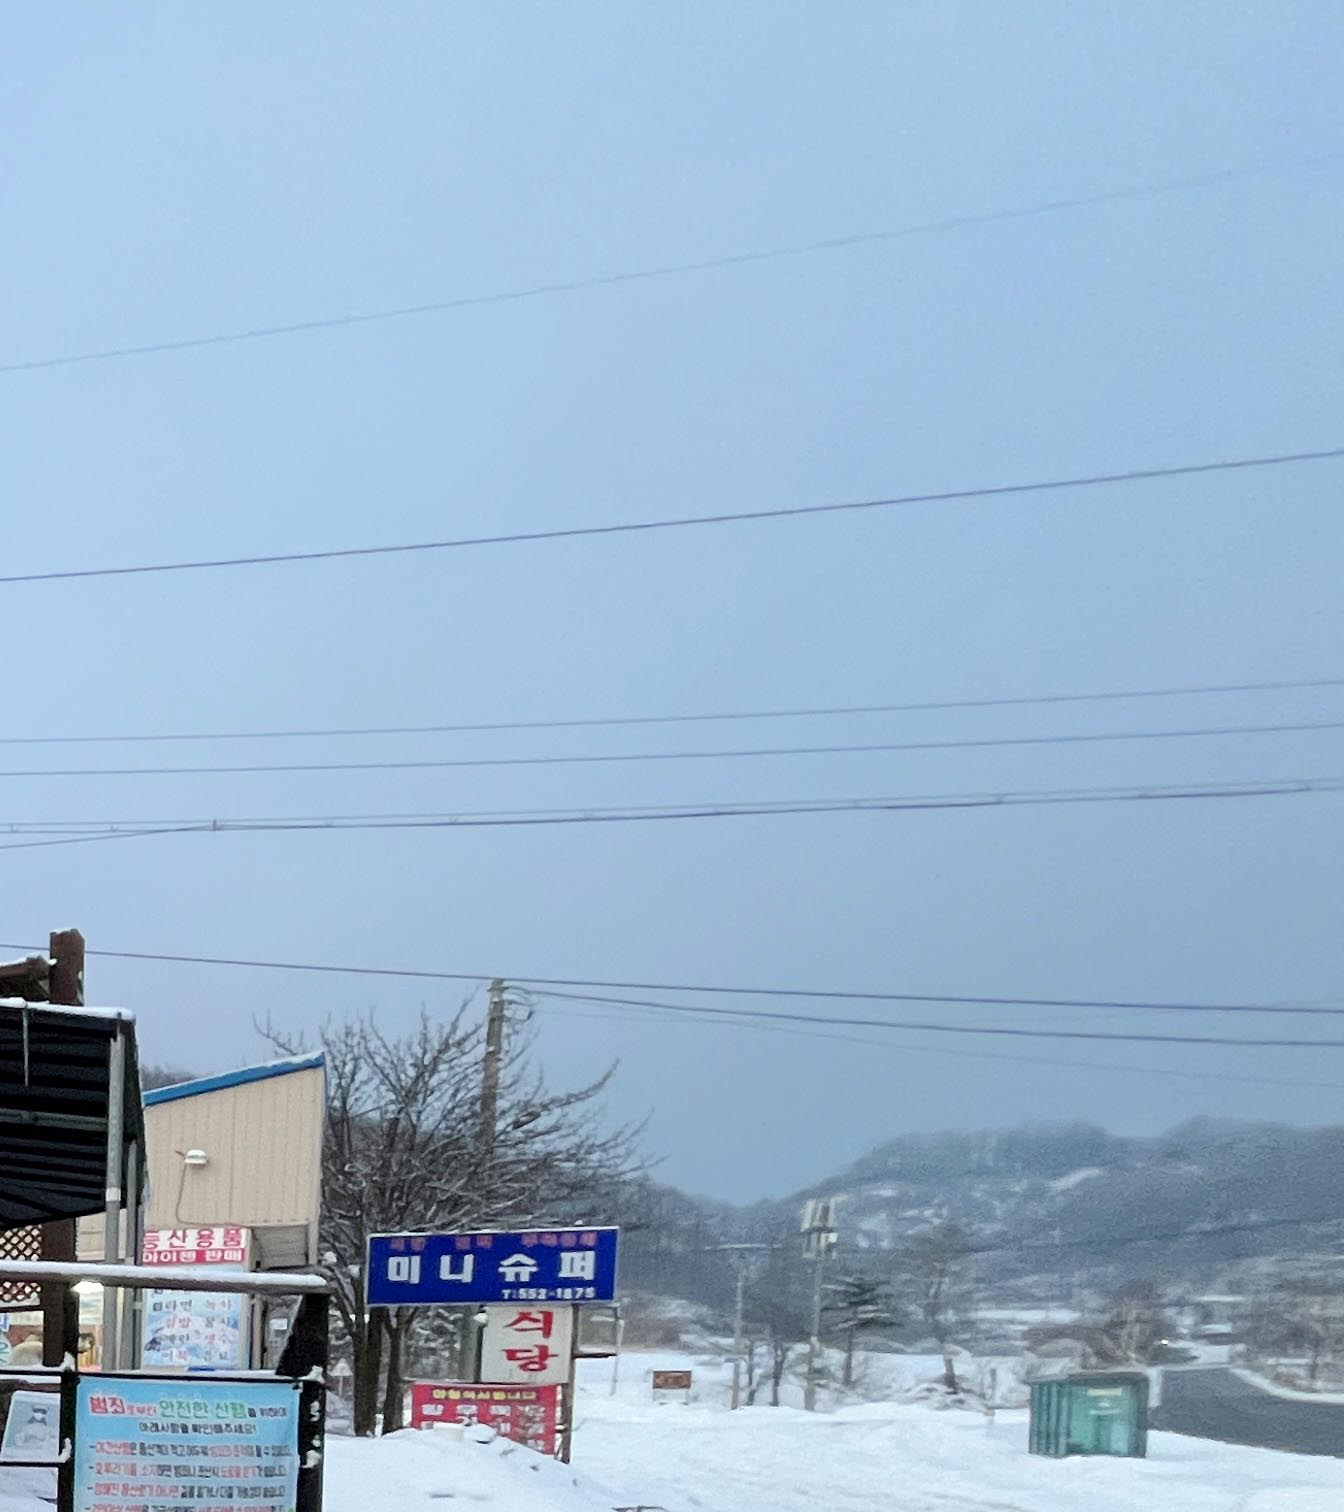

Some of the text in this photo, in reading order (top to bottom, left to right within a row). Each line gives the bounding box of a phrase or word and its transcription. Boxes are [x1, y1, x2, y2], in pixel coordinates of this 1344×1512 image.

[143, 1226, 241, 1249] 등산용품
[205, 1249, 241, 1262] 판매
[387, 1250, 596, 1284] 미니슈퍼
[501, 1311, 559, 1372] 식당
[159, 1400, 208, 1418] 안전한
